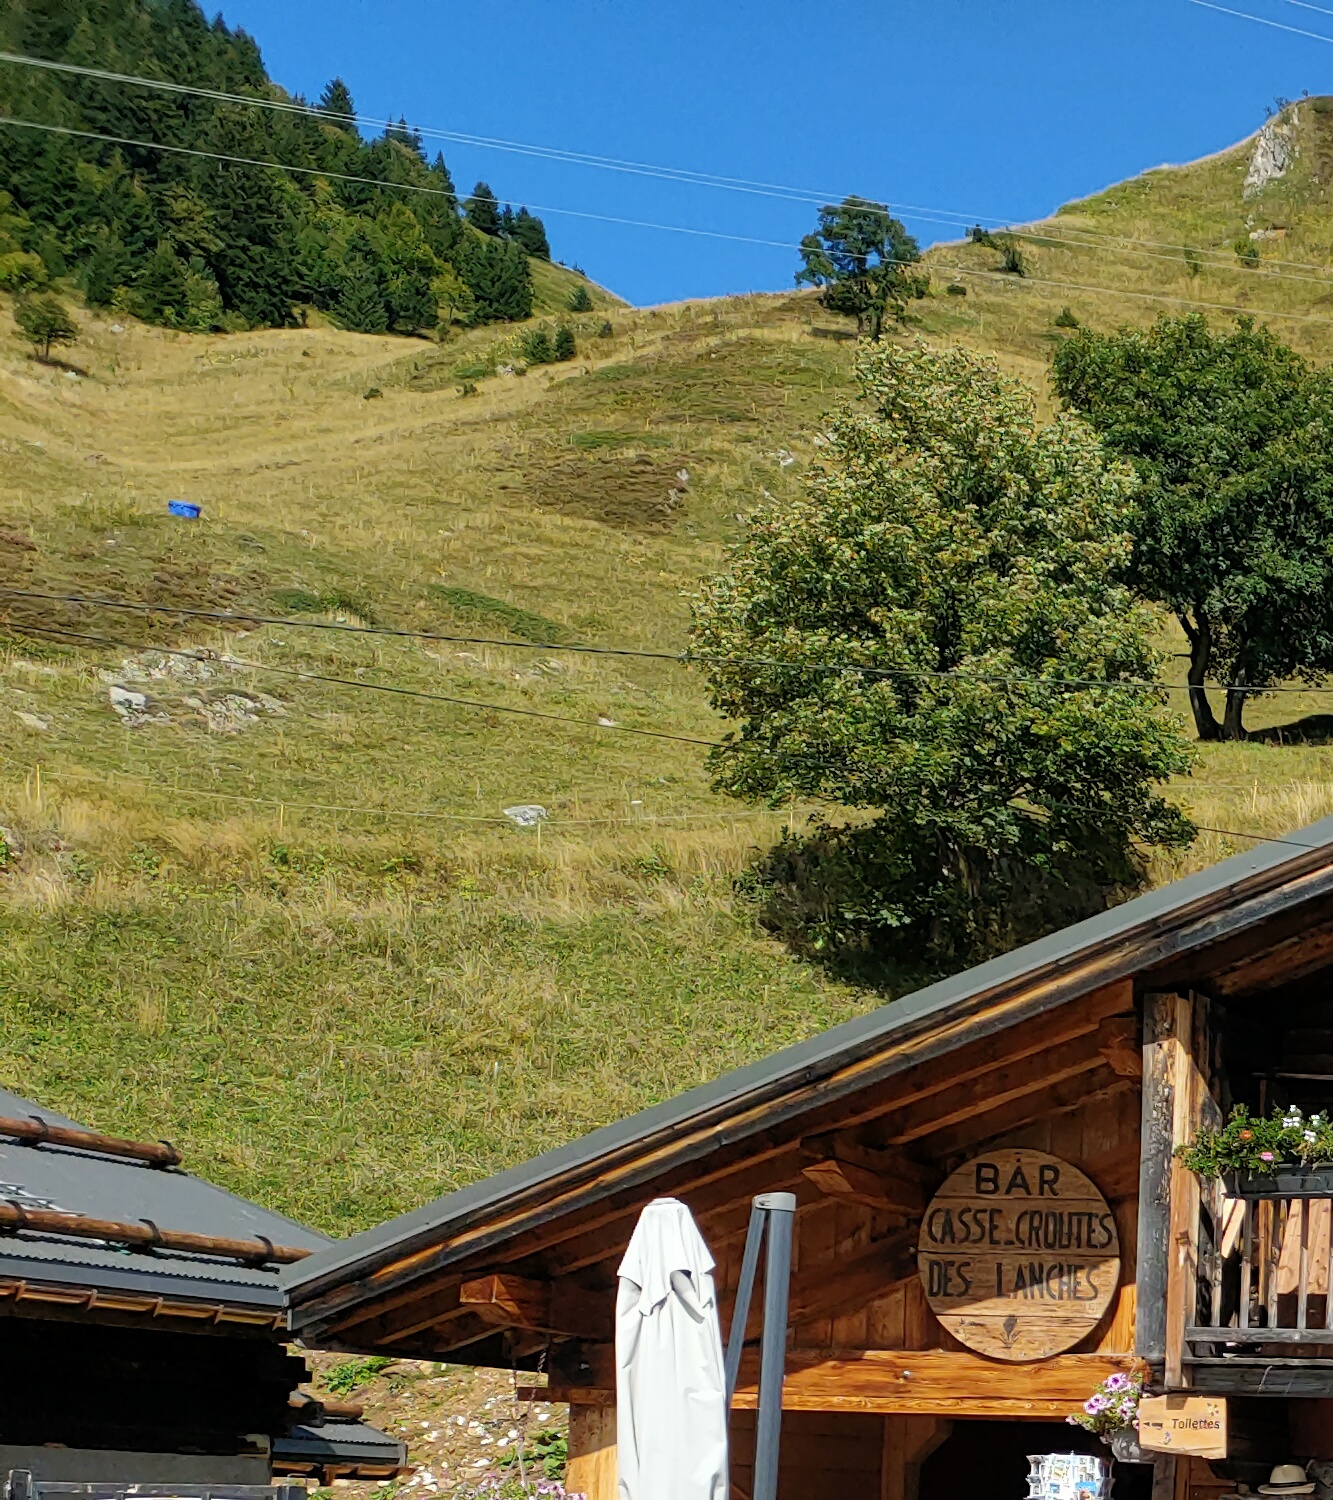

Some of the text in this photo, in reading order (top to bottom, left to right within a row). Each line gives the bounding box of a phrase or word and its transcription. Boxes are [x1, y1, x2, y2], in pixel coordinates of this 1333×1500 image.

[975, 1162, 1060, 1196] BAR
[927, 1259, 972, 1297] DES
[996, 1261, 1099, 1301] LANCHES
[1172, 1418, 1221, 1431] Toilettes
